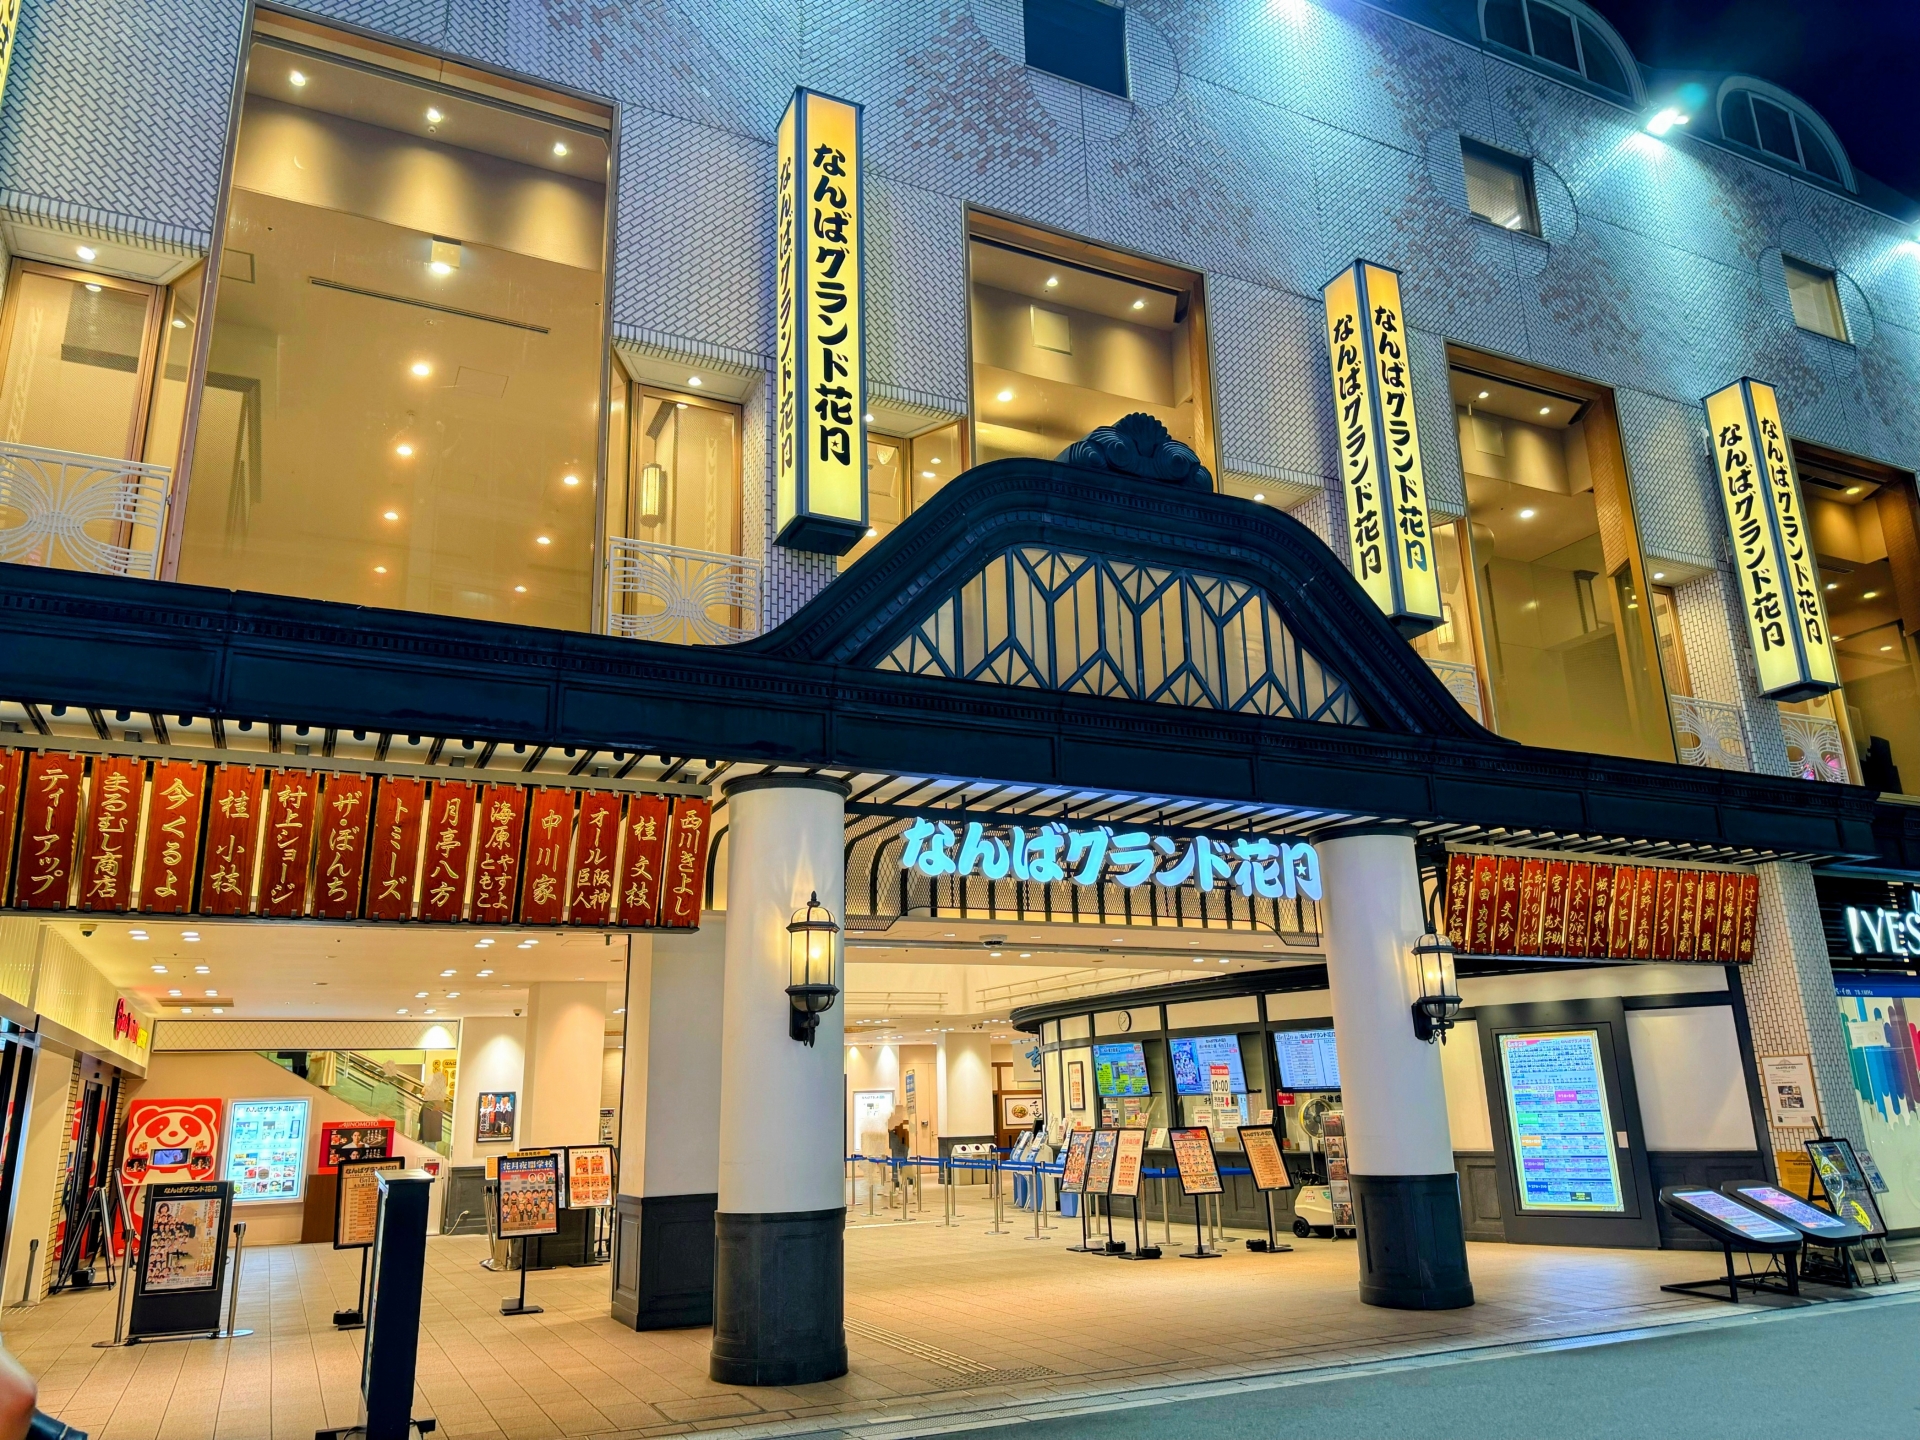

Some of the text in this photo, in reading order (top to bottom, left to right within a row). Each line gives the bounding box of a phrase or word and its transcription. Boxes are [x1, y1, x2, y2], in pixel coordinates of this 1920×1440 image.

[779, 157, 793, 477] なんばグランド花月
[814, 143, 851, 466] なんばグランド花月
[1333, 315, 1381, 581] なんばグランド花月
[1375, 305, 1427, 572] なんばグランド花月
[1719, 423, 1785, 651] なんばグランド花月
[1761, 417, 1822, 645] なんばグランド花月
[30, 768, 69, 895] ティーアップ
[87, 771, 130, 898] まるむし商店
[154, 778, 195, 897] 今くるよ
[210, 789, 250, 895] 桂小枝
[271, 784, 307, 904] 村上ショージ
[327, 792, 363, 902] ザ・ぼんち
[378, 797, 408, 901] トミーズ
[430, 798, 461, 908] 月亭八方
[477, 801, 516, 910] 海原 やすよ ともこ
[531, 809, 563, 905] 中川家
[573, 808, 611, 910] オール 阪神 巨人
[624, 816, 657, 908] 桂文枝
[672, 810, 703, 916] 西川きよし
[900, 816, 1323, 901] なんばグランド花月
[1449, 863, 1468, 945] 笑福亭仁鶴
[1475, 867, 1492, 945] 中田カウス
[1498, 873, 1516, 941] 桂文珍
[1520, 869, 1534, 946] 上方よしお
[1544, 874, 1563, 945] 宮川 大助 花子
[1568, 874, 1587, 947] 大木 こだま ひびき
[1591, 877, 1609, 947] 坂田利夫
[1615, 876, 1631, 949] ハイヒール
[1660, 880, 1674, 951] テンダラー
[1678, 879, 1695, 953] 吉本新喜劇
[1721, 883, 1735, 954] 内場勝則
[1741, 885, 1755, 954] 辻本茂雄
[1212, 1080, 1228, 1091] 10:00
[503, 1160, 553, 1170] 花月夜間学校
